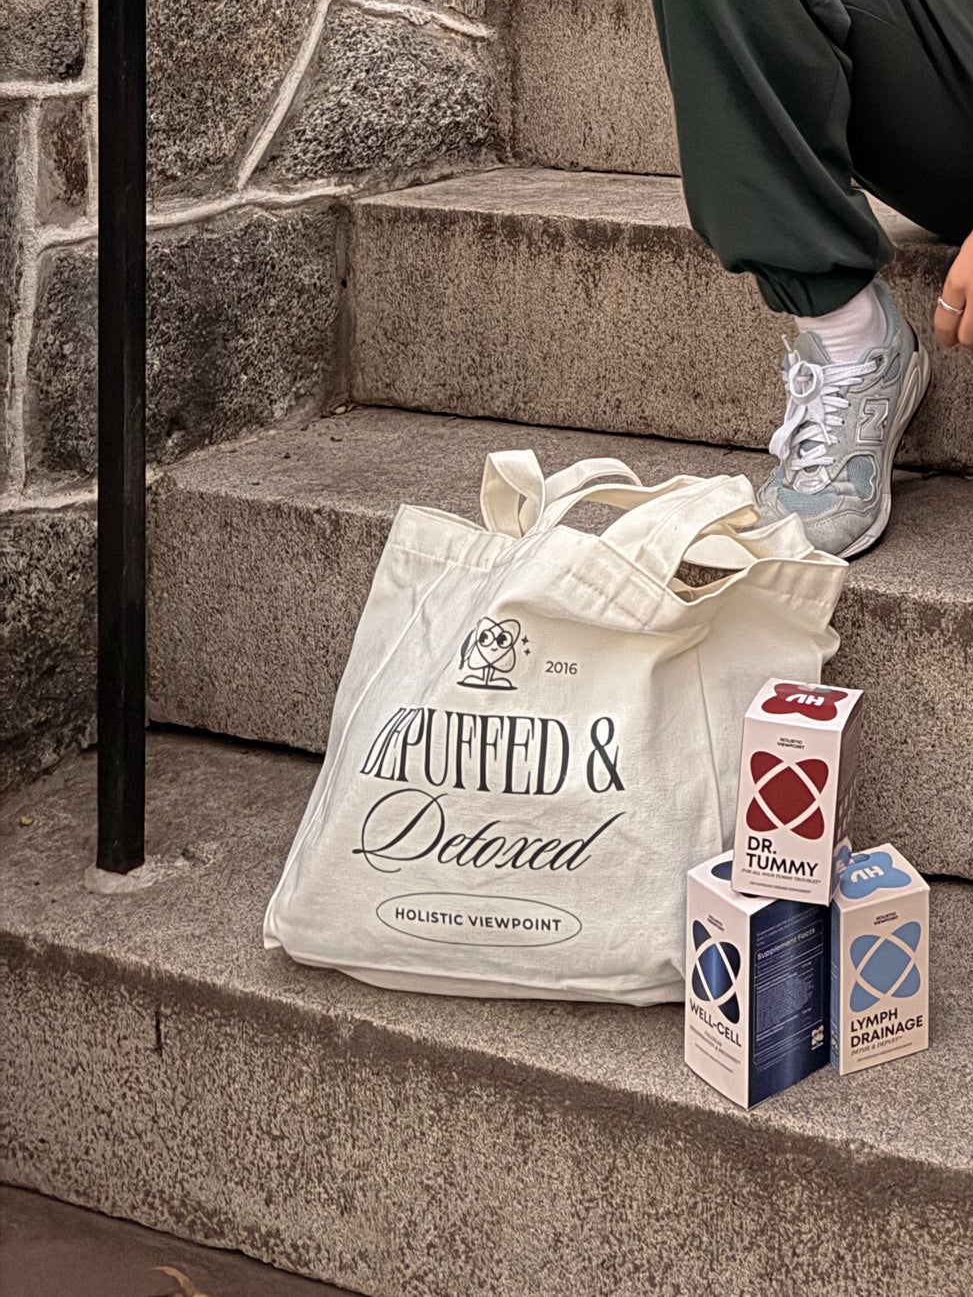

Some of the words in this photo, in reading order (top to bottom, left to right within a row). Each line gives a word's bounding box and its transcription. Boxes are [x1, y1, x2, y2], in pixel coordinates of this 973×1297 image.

[545, 660, 578, 676] 2016
[360, 707, 570, 796] DEPUFFED
[586, 716, 626, 794] &
[352, 788, 627, 873] Detoxed
[747, 835, 777, 855] DR.
[746, 852, 819, 877] TUMMY
[395, 907, 463, 926] HOLISTIC
[468, 915, 562, 932] VIEWPOINT
[689, 998, 742, 1048] WELL-CELL
[851, 1007, 898, 1033] LYMPH
[851, 1015, 924, 1048] DRAINAGE
